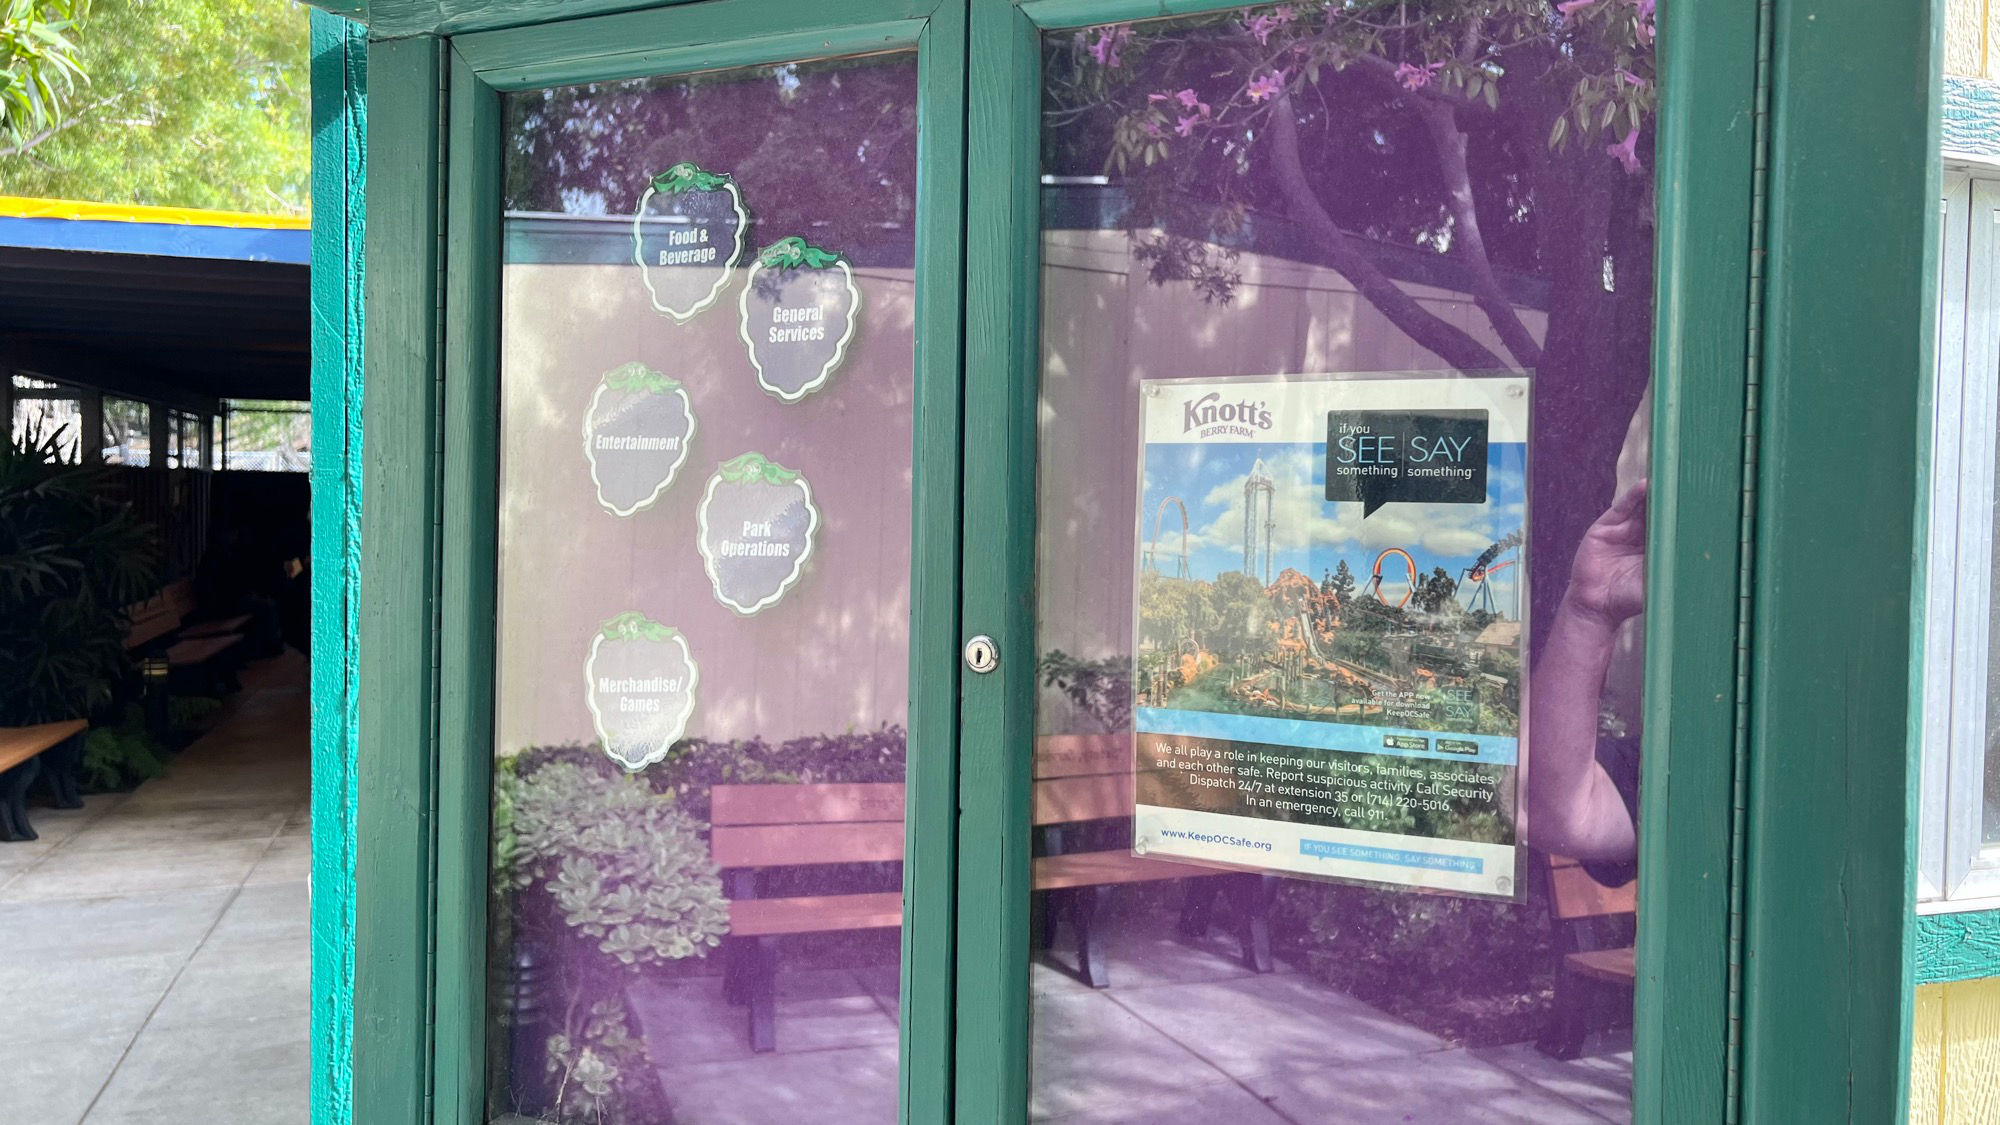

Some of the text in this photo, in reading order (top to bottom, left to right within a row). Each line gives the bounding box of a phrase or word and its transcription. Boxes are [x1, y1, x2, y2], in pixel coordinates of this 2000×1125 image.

[669, 228, 708, 245] Food &
[660, 247, 716, 266] Beverage
[773, 305, 823, 323] General
[769, 325, 824, 343] Services
[1184, 392, 1272, 434] Knott's
[1201, 425, 1254, 438] BERRY FARM
[1339, 423, 1370, 436] if you
[596, 435, 679, 450] Entertainment
[1337, 436, 1472, 464] SEE SAY
[1337, 465, 1398, 478] something
[743, 520, 771, 537] Park
[721, 539, 790, 557] Operations
[600, 676, 683, 693] Merchandise/
[1386, 690, 1397, 698] the
[1399, 691, 1414, 699] APP
[1447, 690, 1472, 702] SEE
[620, 696, 660, 712] Games
[1352, 697, 1430, 710] available for download
[1446, 706, 1472, 718] SAY
[1387, 709, 1430, 719] KeepOCSafe
[1155, 743, 1495, 785] We all play a role in keeping our visitors, families, associates
[1156, 758, 1493, 803] and each other safe. Report suspicious activity. Call Security
[1190, 774, 1452, 812] Dispatch 24/7 at extension 35 or (714) 220-5016.
[1246, 794, 1388, 821] In an emergency, call 911.
[1161, 828, 1272, 852] www.KeepOCSafe.org
[1304, 844, 1312, 852] IF
[1314, 845, 1330, 853] YOU
[1330, 847, 1348, 856] SEE
[1405, 855, 1421, 863] SAY
